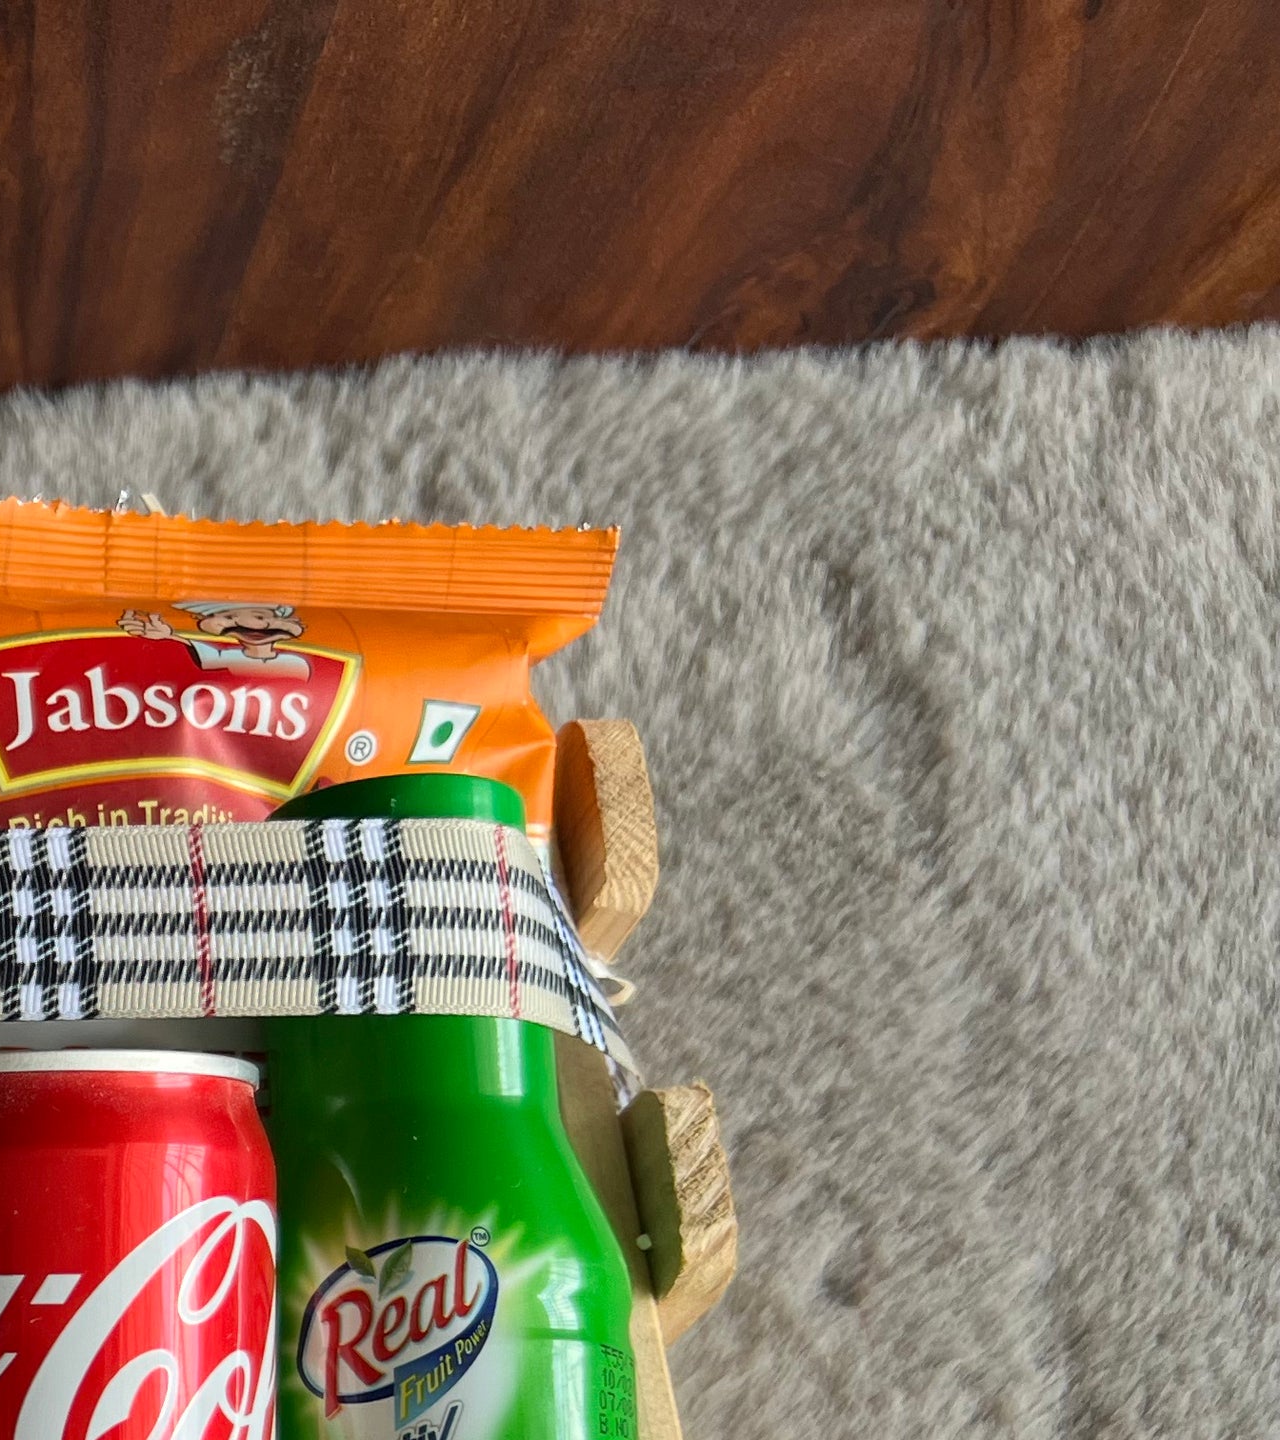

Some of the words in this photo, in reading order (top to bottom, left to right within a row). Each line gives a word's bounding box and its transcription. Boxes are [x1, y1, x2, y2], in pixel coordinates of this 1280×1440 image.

[1, 666, 310, 752] Jabsons
[322, 1238, 482, 1420] Real
[399, 1355, 454, 1421] Fruit
[454, 1318, 488, 1366] Power
